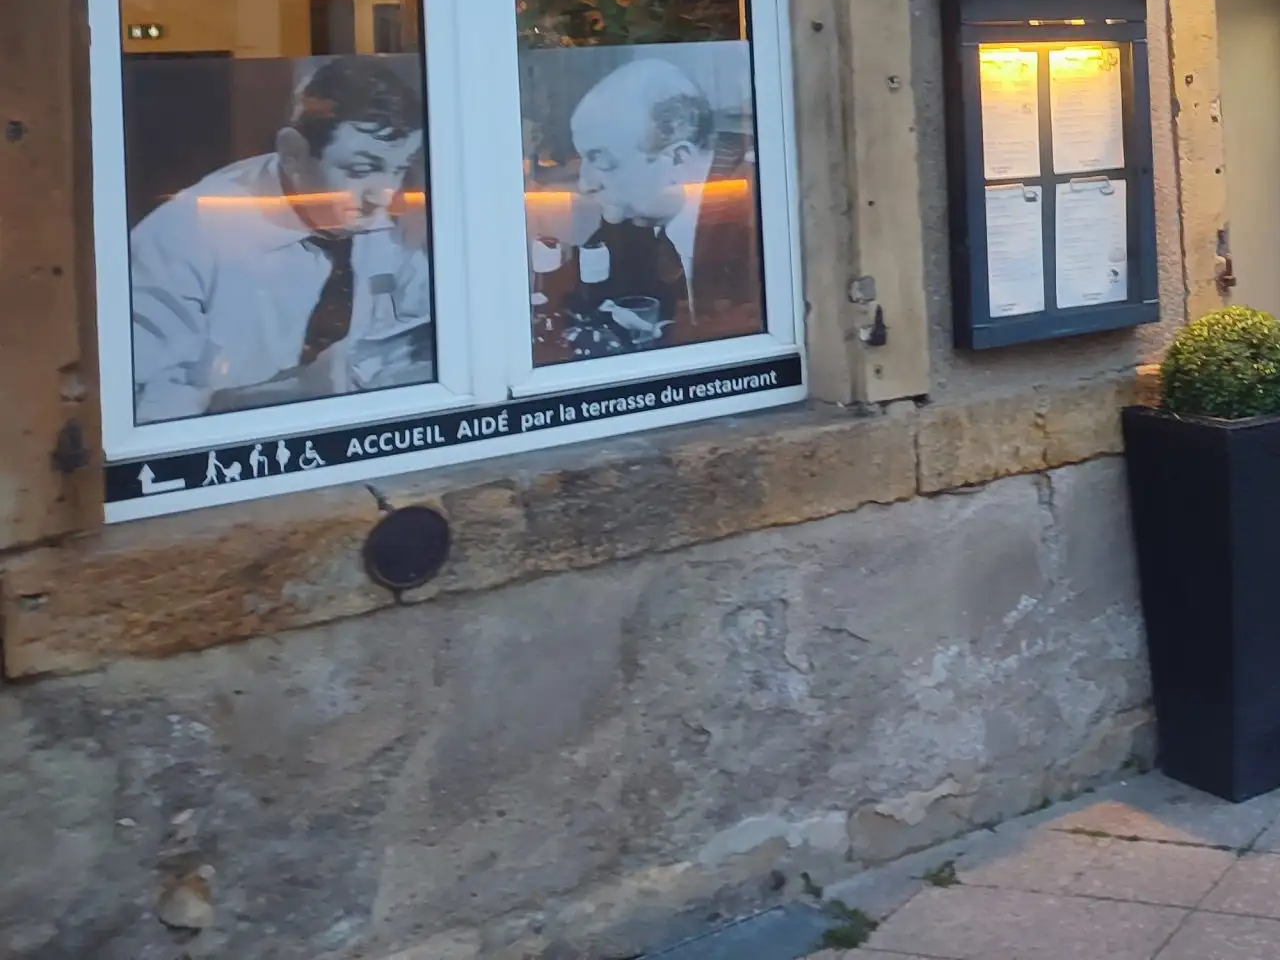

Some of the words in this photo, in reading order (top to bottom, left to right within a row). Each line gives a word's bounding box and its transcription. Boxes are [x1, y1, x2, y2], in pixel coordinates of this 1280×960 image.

[346, 424, 446, 458] ACCUEIL
[456, 409, 509, 439] AIDÉ
[521, 409, 554, 432] par
[559, 403, 576, 423] la
[581, 391, 656, 418] terrasse
[660, 385, 684, 404] du
[688, 369, 778, 399] restaurant
